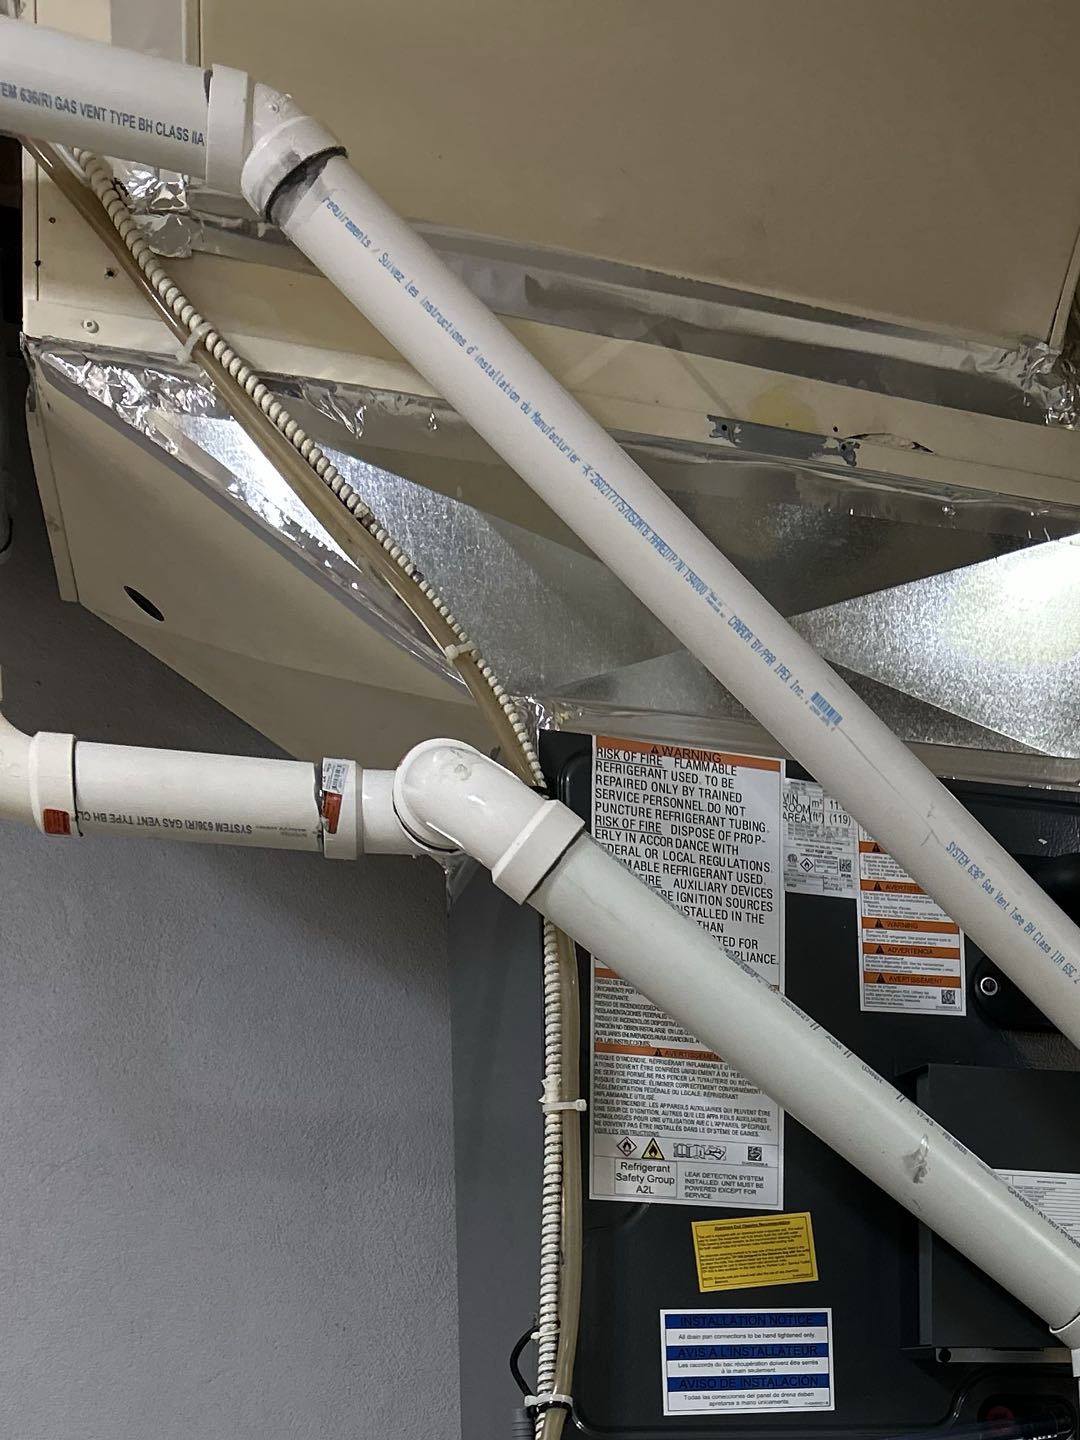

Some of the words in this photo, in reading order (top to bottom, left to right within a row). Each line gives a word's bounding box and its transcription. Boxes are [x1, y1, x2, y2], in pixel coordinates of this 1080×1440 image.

[55, 96, 77, 114] GAS
[80, 103, 106, 122] VENT
[110, 109, 136, 129] TYPE
[138, 117, 153, 134] BH
[156, 122, 189, 141] CLASS
[191, 129, 205, 146] IIA
[323, 196, 372, 248] requirements
[378, 252, 405, 283] Suivez
[405, 280, 419, 298] les
[420, 296, 467, 348] instructions
[520, 401, 532, 415] du
[531, 410, 581, 465] Manufacturier
[727, 615, 754, 642] CANADA
[773, 662, 792, 684] IPEX
[596, 748, 620, 761] RISK
[623, 751, 637, 762] OF
[640, 754, 663, 766] FIRE
[674, 758, 737, 776] FLAMMABLE
[661, 747, 722, 764] WARNING
[596, 761, 668, 780] REFRIGERANT
[705, 775, 718, 787] TO
[721, 778, 734, 789] BE
[596, 775, 648, 791] REPAIRED
[651, 782, 679, 795] ONLY
[682, 786, 695, 797] BY
[698, 787, 742, 803] TRAINED
[595, 788, 640, 803] SERVICE
[707, 802, 721, 814] DO
[725, 805, 746, 817] NOT
[783, 803, 810, 814] ROOM
[595, 802, 652, 818] PUNCTURE
[655, 808, 726, 827] REFRIGERANT
[783, 812, 807, 823] AREA
[829, 813, 851, 826] (119)
[595, 815, 618, 828] RISK
[622, 818, 636, 829] OF
[639, 820, 662, 833] FIRE
[670, 825, 715, 840] DISPOSE
[718, 830, 732, 841] OF
[595, 829, 622, 842] ERLY
[625, 831, 636, 843] IN
[639, 834, 710, 853] ACCORDANCE
[712, 844, 739, 856] WITH
[644, 848, 659, 859] OR
[662, 851, 696, 864] LOCAL
[662, 864, 733, 882] REFRIGERANT
[673, 878, 728, 894] AUXILIARY
[731, 885, 773, 899] DEVICES
[946, 841, 971, 868] SYSTEM
[982, 879, 995, 894] Gas
[994, 891, 1010, 910] Vent
[1009, 907, 1024, 926] Type
[1024, 922, 1036, 936] BH
[1033, 932, 1051, 953] Class
[676, 891, 723, 906] IGNITION
[725, 898, 773, 912] SOURCES
[731, 910, 742, 921] IN
[745, 913, 765, 924] THE
[738, 938, 758, 949] FOR
[620, 1161, 670, 1174] Refrigerant
[702, 1172, 737, 1180] DETECTION
[616, 1173, 645, 1184] Safety
[647, 1175, 675, 1185] Group
[636, 1185, 654, 1194] A2L
[680, 1315, 766, 1326] INSTALLATION
[769, 1315, 814, 1325] NOTICE
[678, 1347, 706, 1358] AVIS
[680, 1378, 718, 1389] AVISO
[720, 1378, 737, 1388] DE
